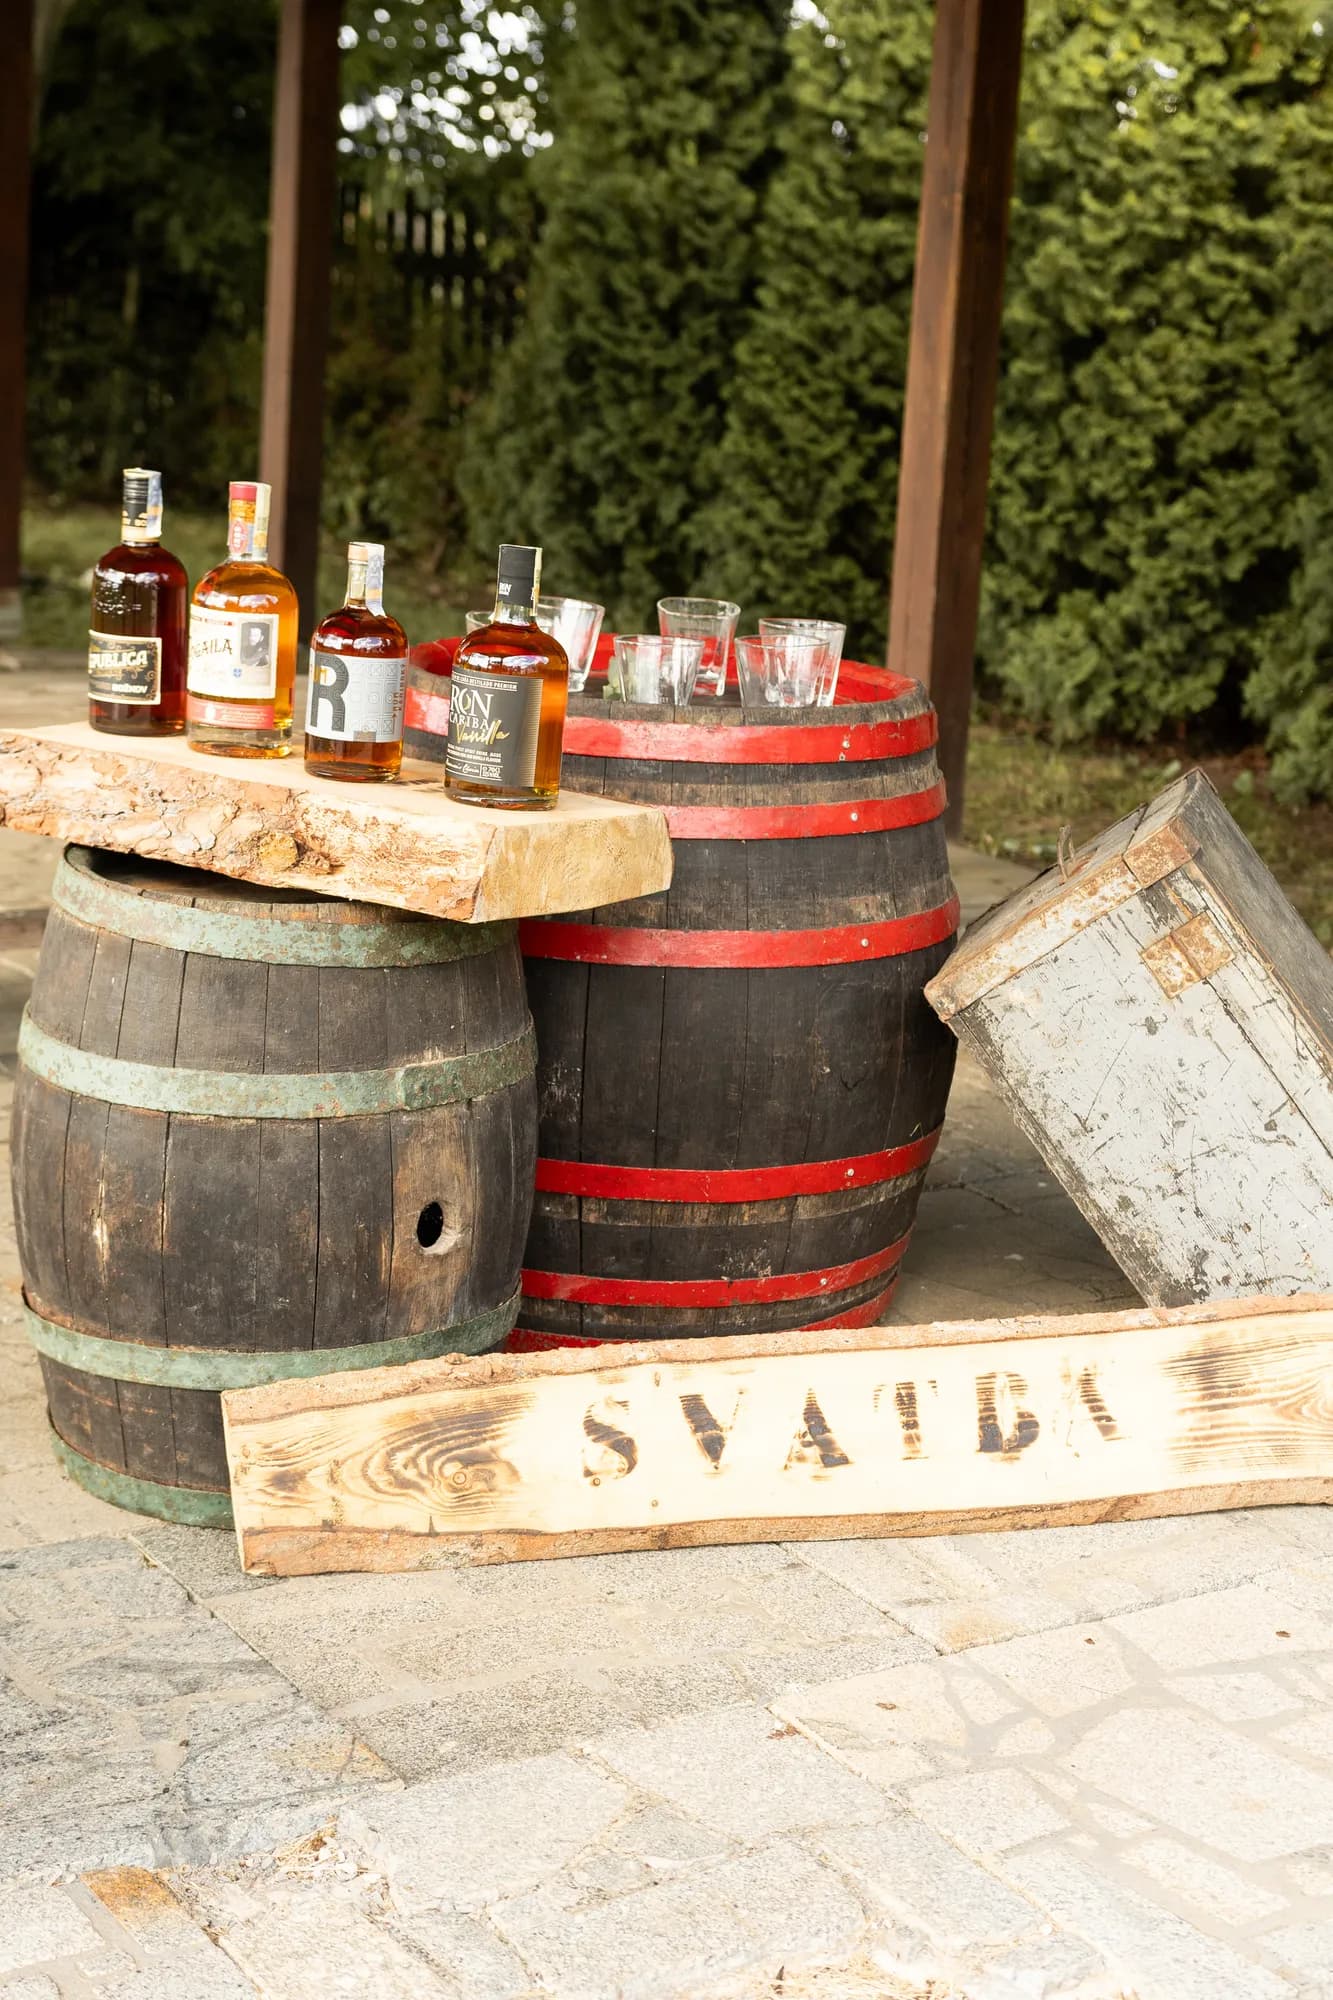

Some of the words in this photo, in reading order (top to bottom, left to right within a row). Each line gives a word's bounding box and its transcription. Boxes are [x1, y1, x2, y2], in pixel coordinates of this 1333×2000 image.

[450, 684, 494, 719] RON
[456, 719, 510, 745] Vanilla
[583, 1367, 1129, 1478] SVATBA
